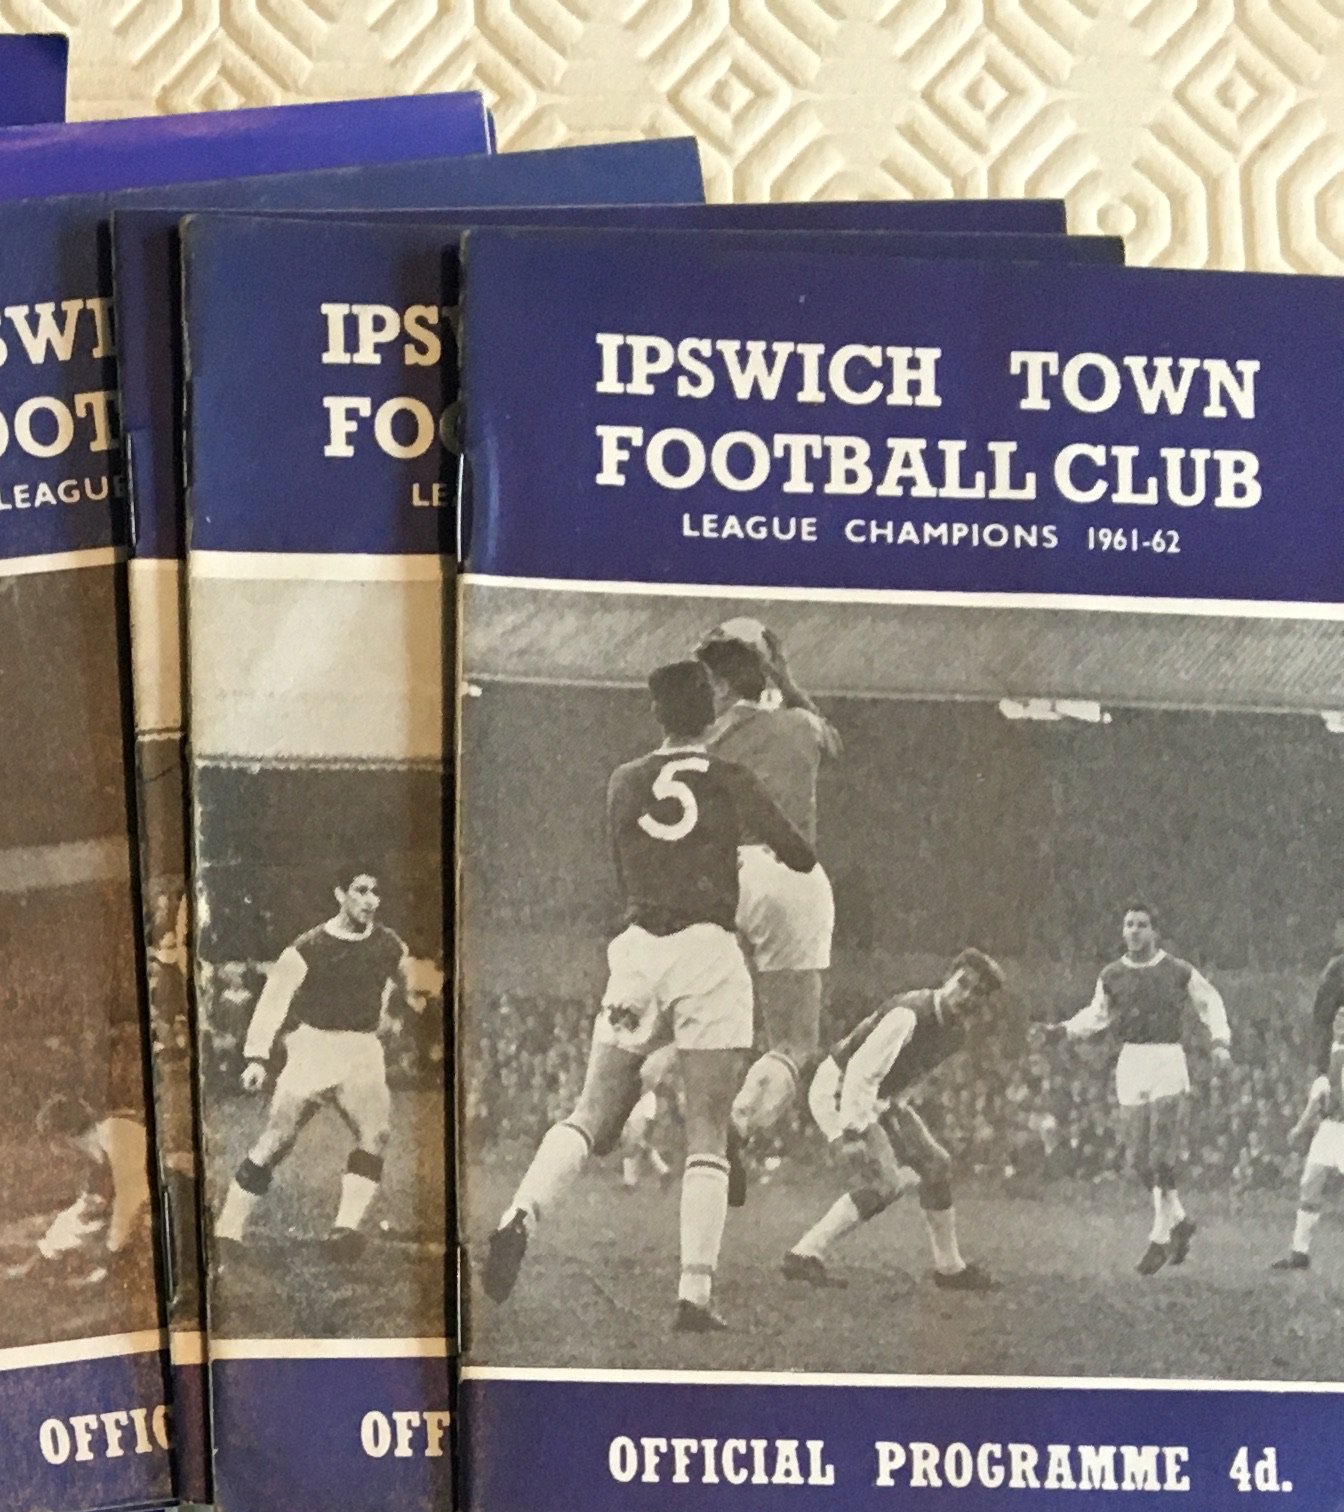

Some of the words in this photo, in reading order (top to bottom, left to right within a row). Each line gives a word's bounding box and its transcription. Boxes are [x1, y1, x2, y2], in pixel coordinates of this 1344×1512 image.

[597, 334, 942, 407] IPSWICH
[1010, 350, 1260, 419] TOWN
[596, 425, 1036, 501] FOOTBALL
[1054, 447, 1263, 509] CLUB
[683, 513, 818, 544] LEAGUE
[845, 519, 1059, 550] CHAMPIONS
[1087, 527, 1181, 554] 1961-62
[637, 757, 710, 842] 5
[608, 1435, 835, 1486] OFFICIAL
[875, 1441, 1190, 1492] PROGRAMME
[1228, 1446, 1293, 1493] 4d.
